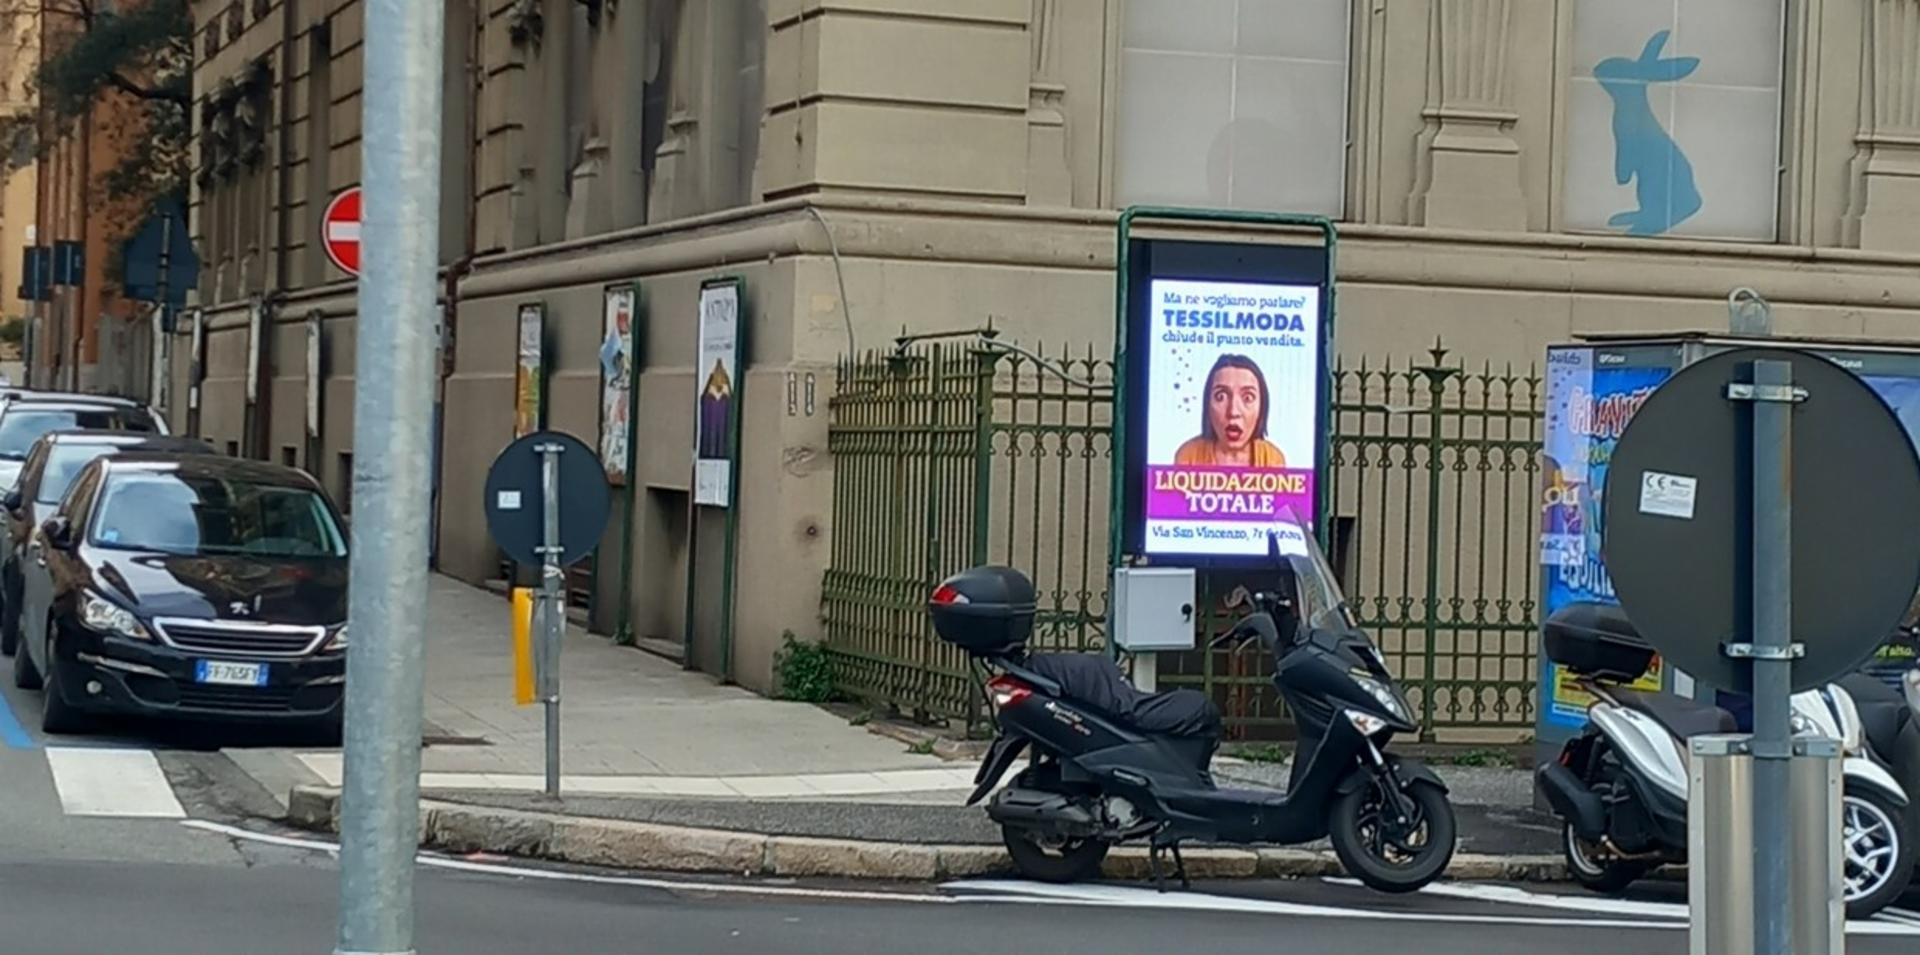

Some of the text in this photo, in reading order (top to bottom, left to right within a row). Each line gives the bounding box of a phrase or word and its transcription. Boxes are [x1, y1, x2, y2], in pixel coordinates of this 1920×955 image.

[1163, 292, 1307, 310] Ma ne vogliamo parlare?
[1163, 309, 1305, 331] TESSILMODA
[1162, 330, 1305, 347] chiude il punto vendita.
[1154, 470, 1306, 494] LIQUIDAZIONE
[1185, 493, 1275, 514] TOTALE
[1152, 525, 1170, 538] Via
[1172, 526, 1194, 538] San
[1196, 526, 1249, 541] Vincenzo,
